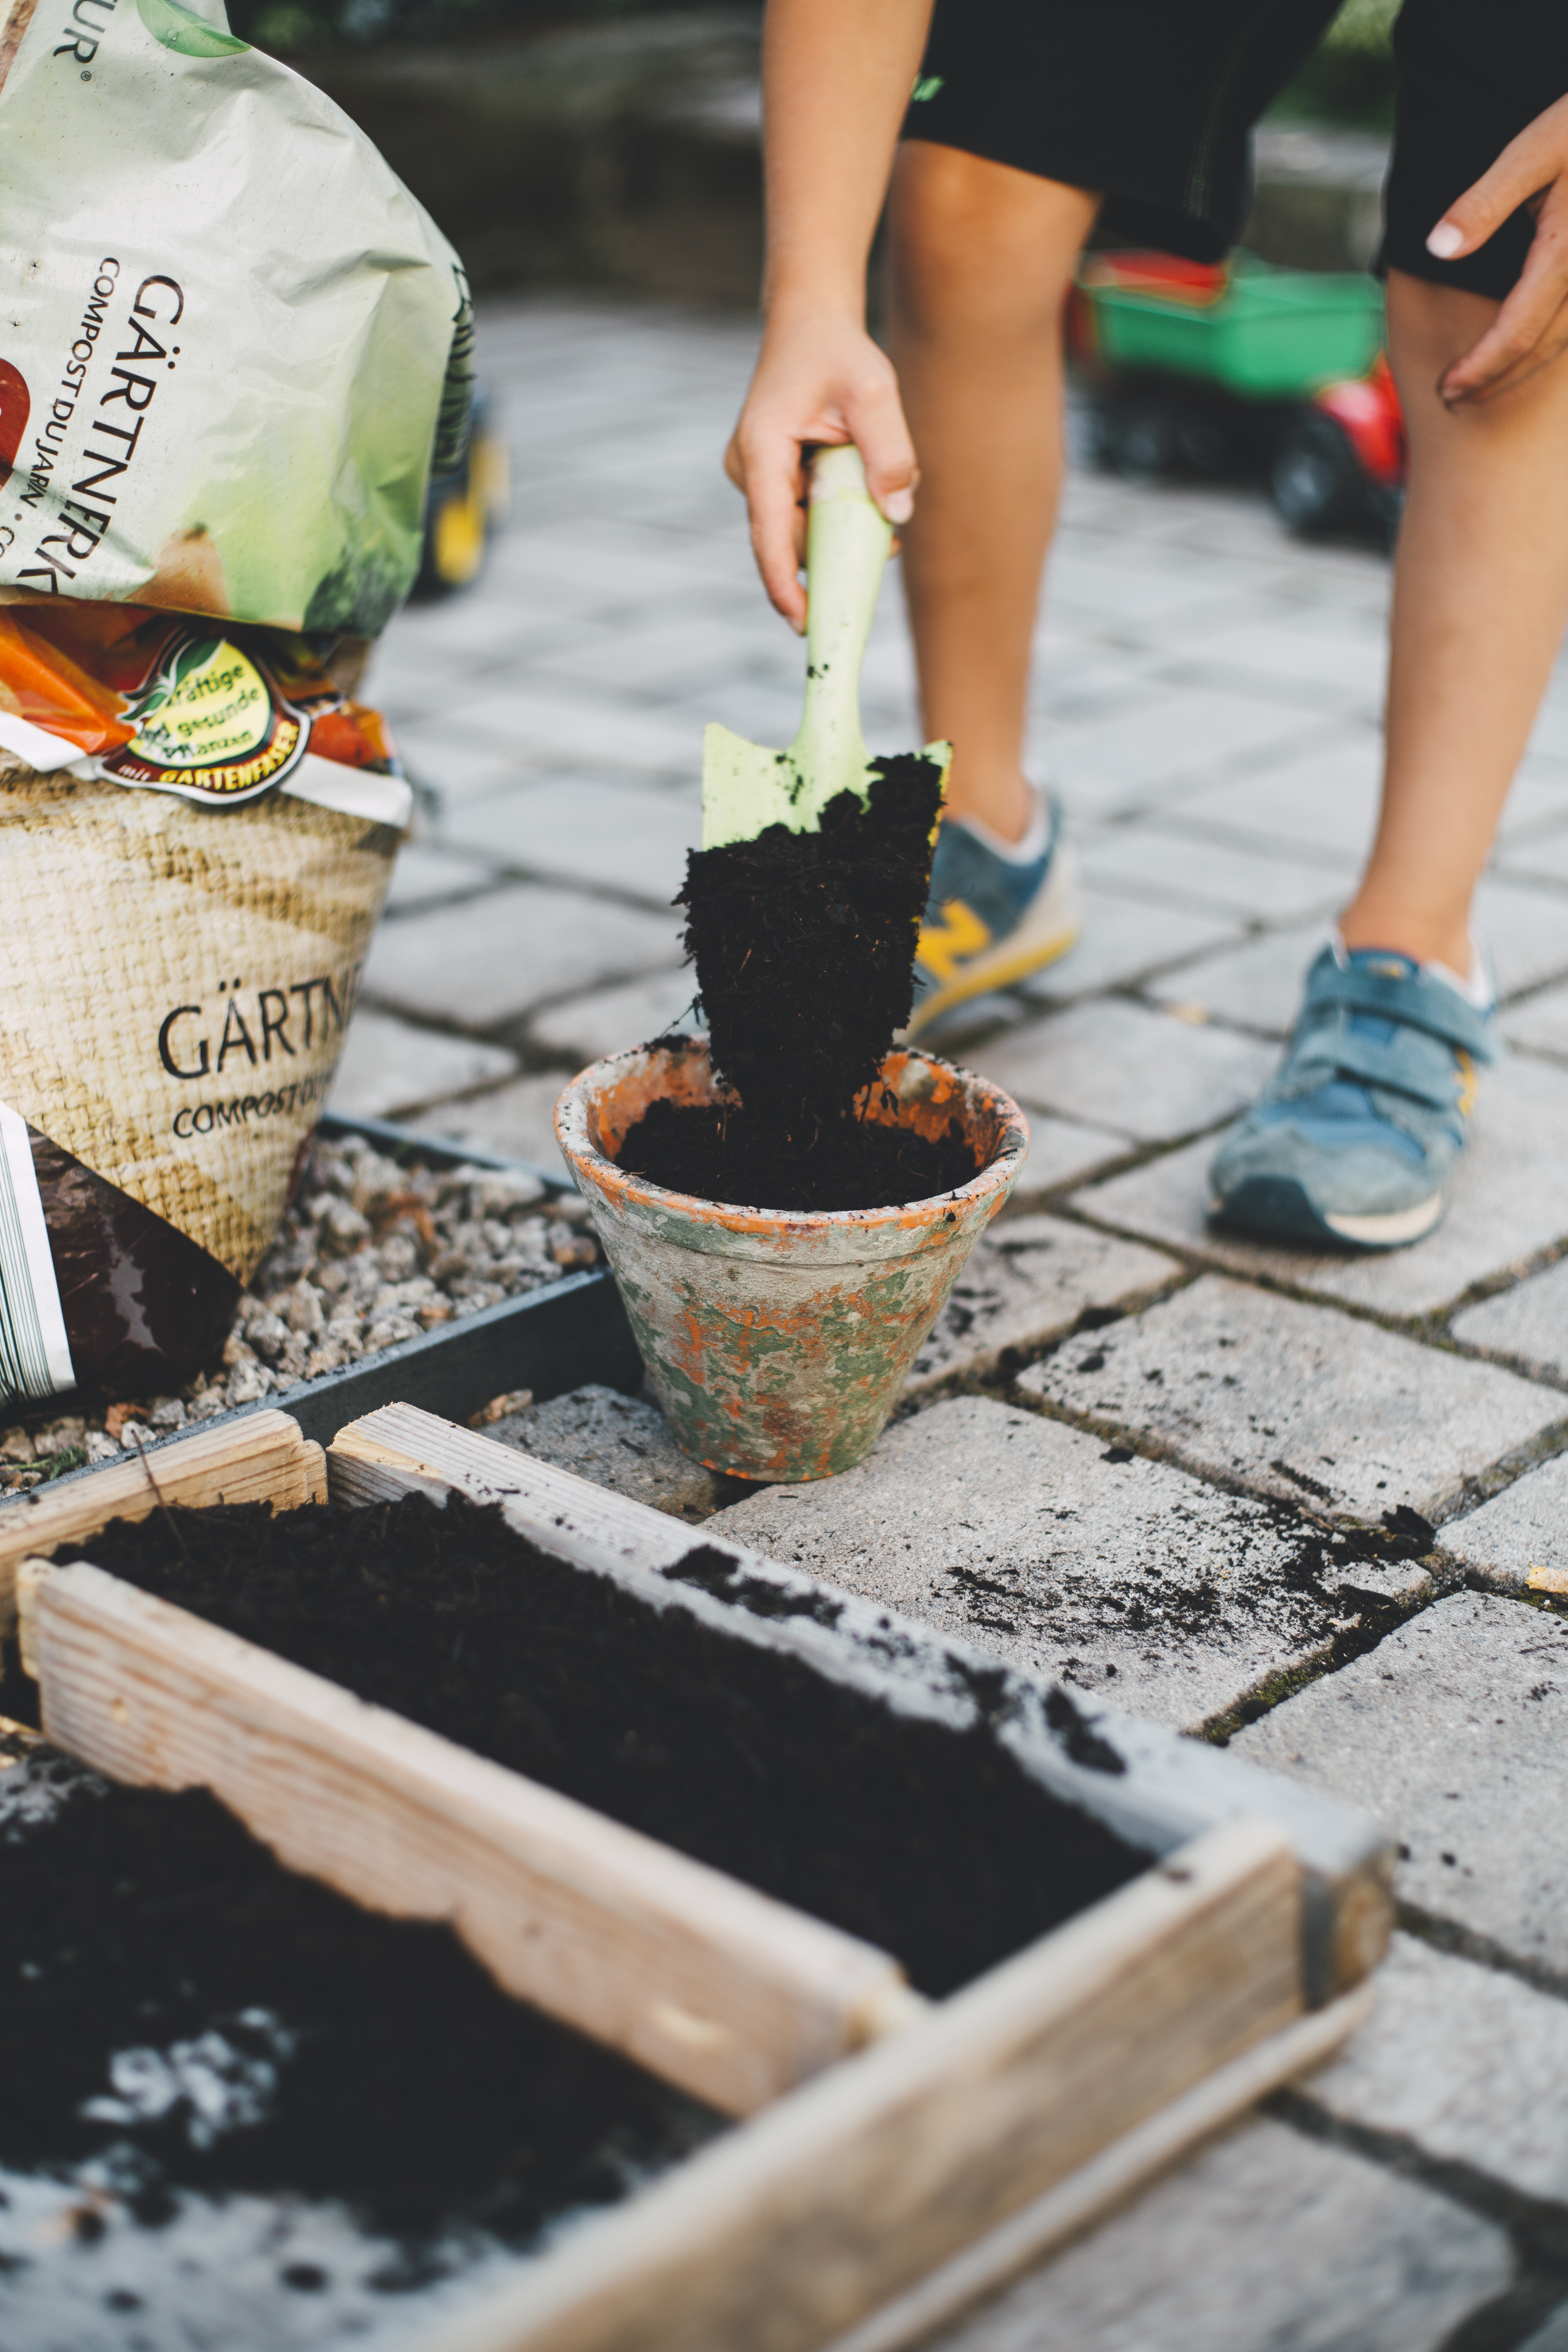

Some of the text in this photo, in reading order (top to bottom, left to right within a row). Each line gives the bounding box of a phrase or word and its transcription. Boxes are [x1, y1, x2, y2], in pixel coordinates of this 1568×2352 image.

[61, 257, 120, 397] COMPOST
[45, 398, 75, 443] DU
[178, 689, 260, 737] gesunde
[158, 719, 299, 791] GARTENFASER
[173, 1083, 298, 1139] COMPOST
